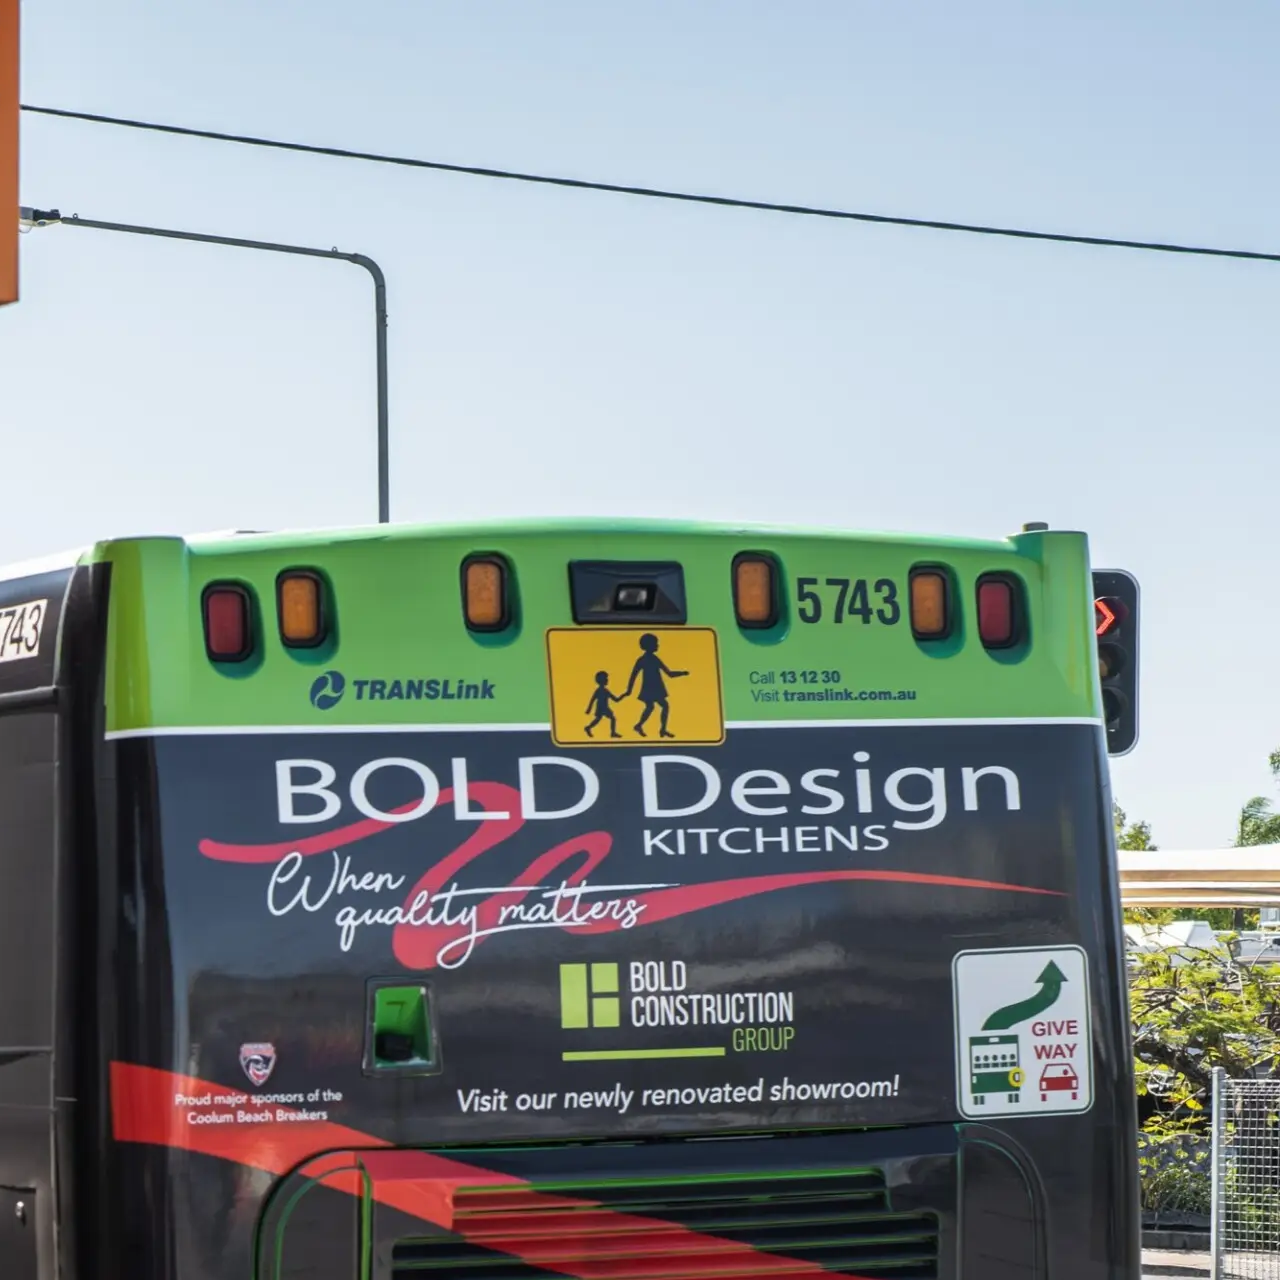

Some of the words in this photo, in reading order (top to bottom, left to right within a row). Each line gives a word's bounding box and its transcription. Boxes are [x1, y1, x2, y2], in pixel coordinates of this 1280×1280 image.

[797, 577, 901, 626] 5743
[352, 678, 497, 701] TRANSLink
[749, 670, 775, 684] Call
[780, 670, 797, 684] 13
[800, 670, 818, 684] 12
[821, 670, 841, 684] 30
[751, 688, 780, 702] Visit
[783, 687, 917, 702] translink.com.au
[274, 755, 601, 825] BOLD
[640, 750, 1022, 831] Design
[643, 823, 890, 857] KITCHENS
[267, 851, 406, 916] When
[335, 880, 480, 969] quality
[497, 879, 648, 929] matters
[630, 960, 687, 993] BOLD
[631, 991, 795, 1028] CONSTRUCTION
[732, 1026, 796, 1052] GROUP
[1031, 1019, 1079, 1037] GIVE
[1033, 1042, 1078, 1061] WAY
[175, 1092, 211, 1106] Proud
[214, 1091, 248, 1108] major
[251, 1091, 304, 1107] sponsors
[307, 1089, 320, 1102] of
[322, 1088, 343, 1102] the
[457, 1088, 508, 1113] Visit
[515, 1091, 554, 1111] our
[563, 1082, 634, 1114] newly
[642, 1078, 764, 1107] renovated
[769, 1074, 900, 1102] showroom!
[187, 1110, 234, 1125] Coolum
[237, 1110, 273, 1123] Beach
[276, 1108, 328, 1122] Breakers
